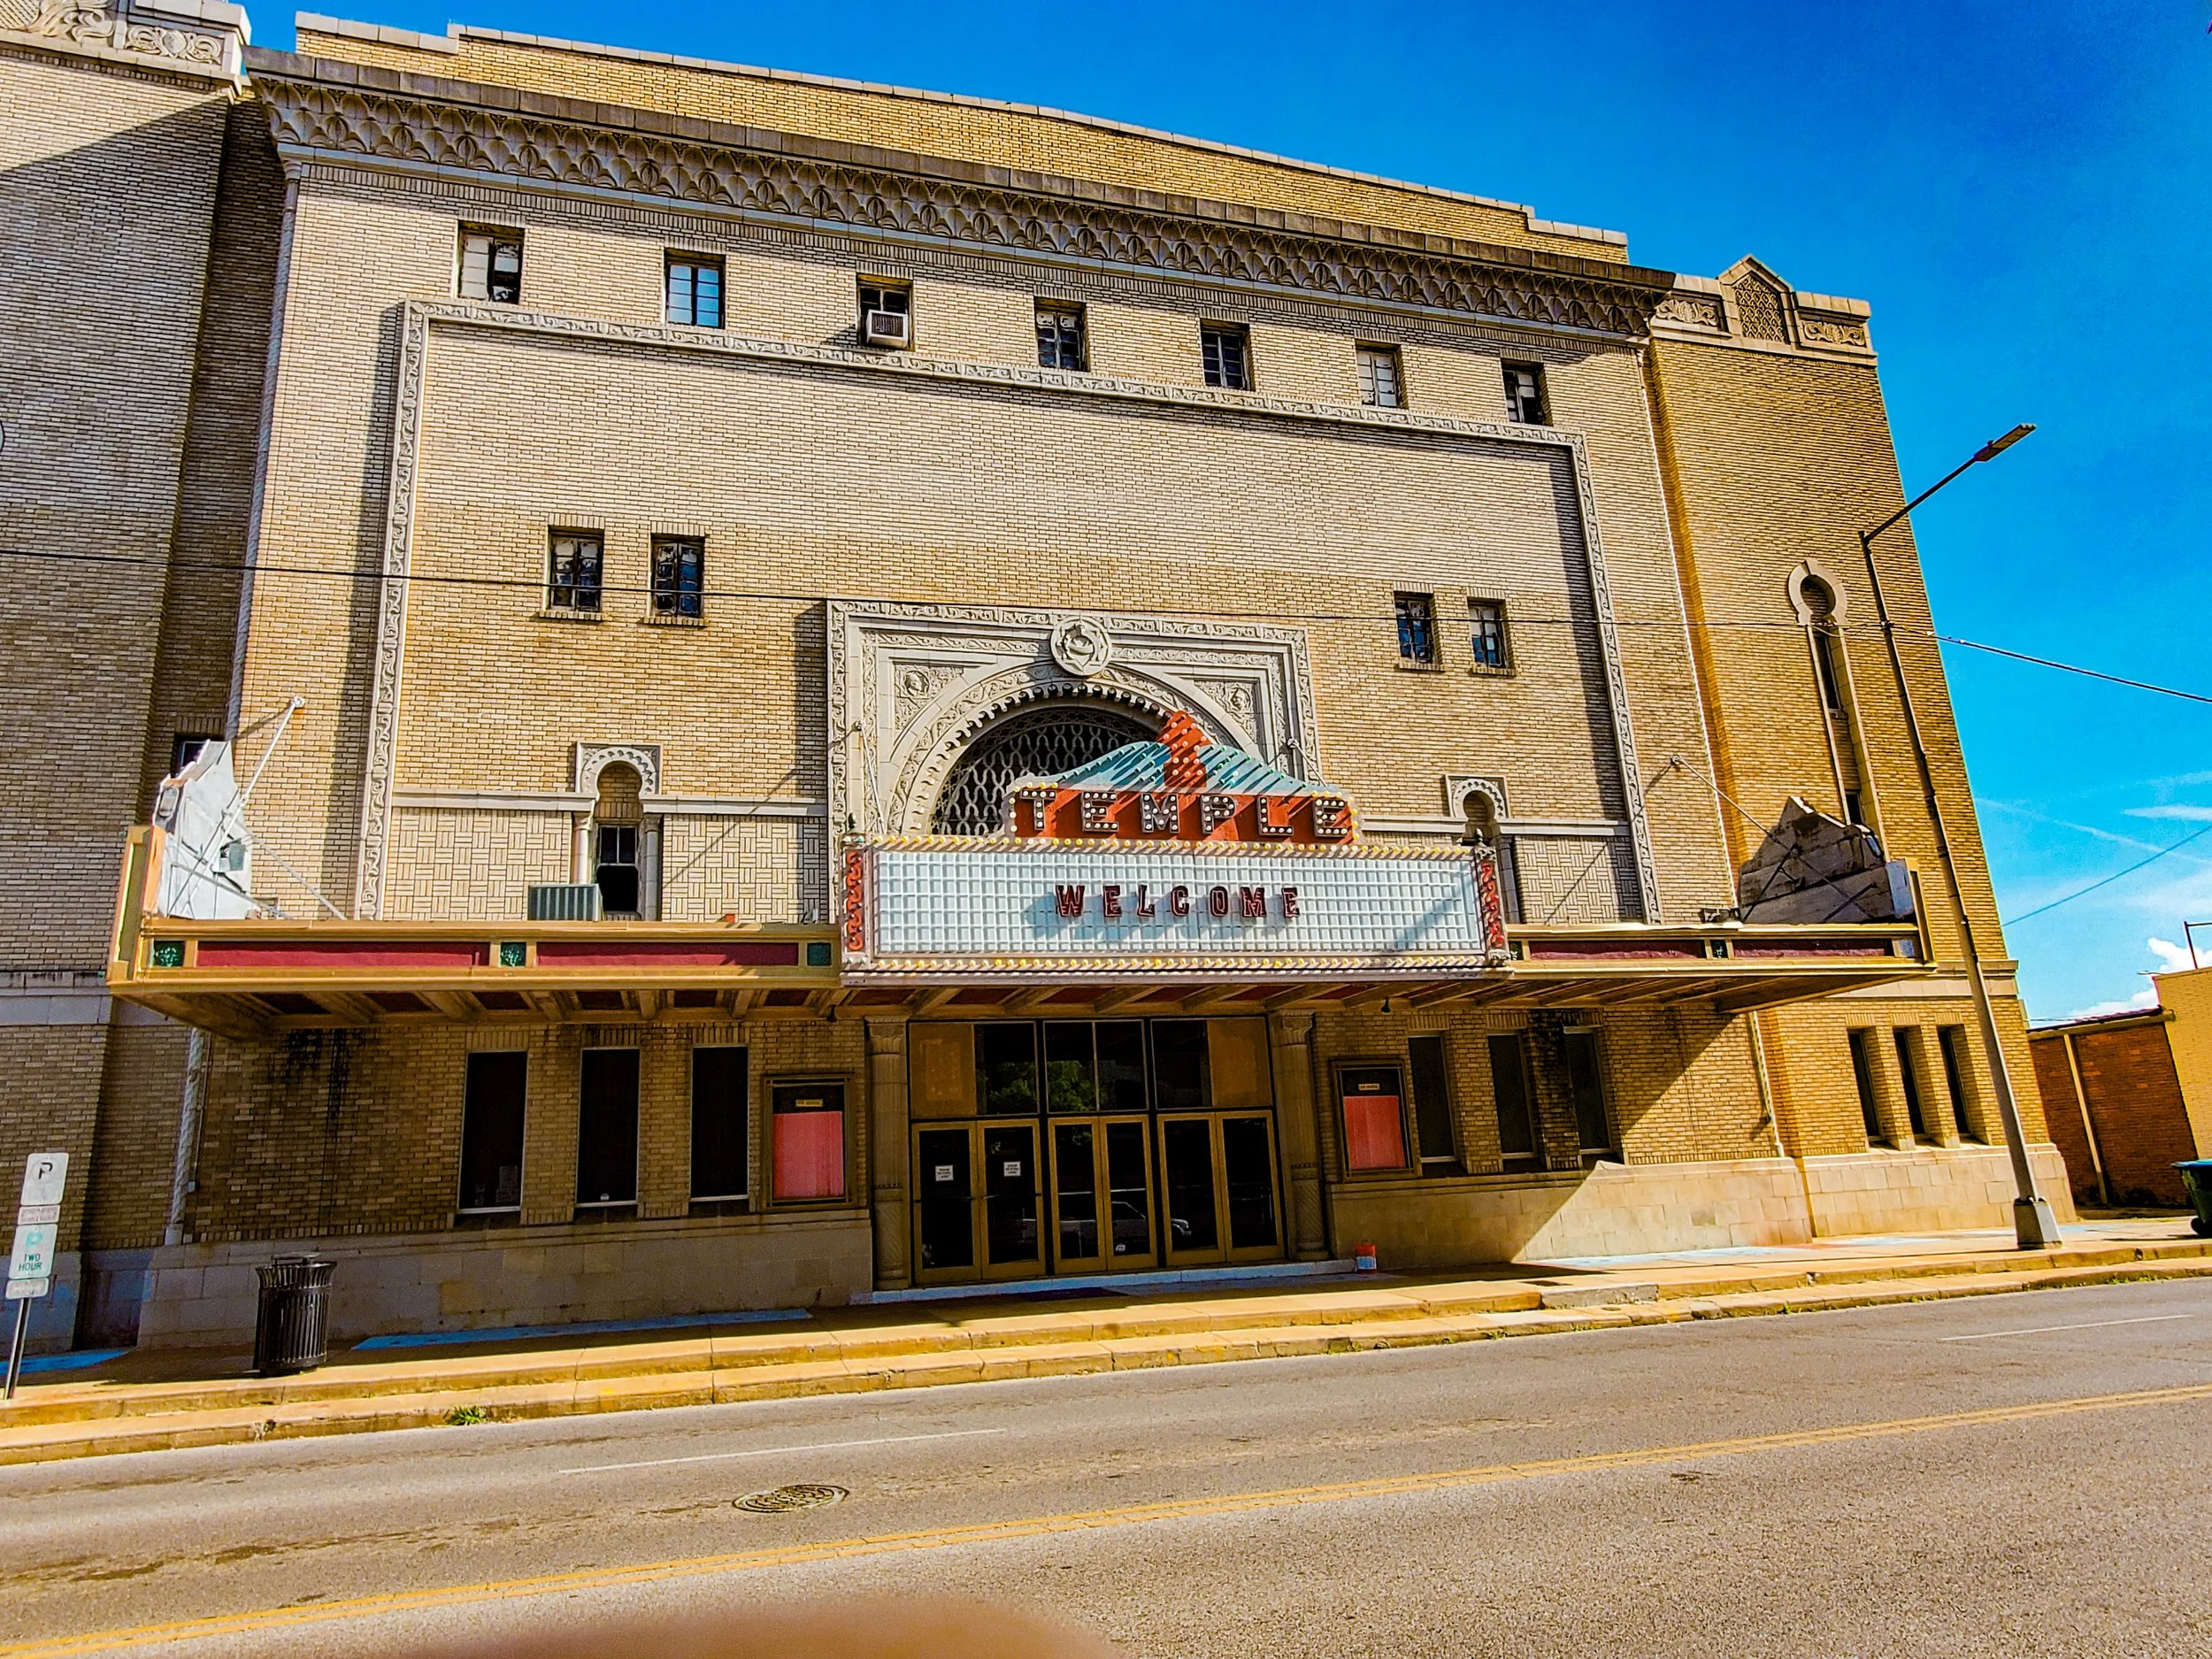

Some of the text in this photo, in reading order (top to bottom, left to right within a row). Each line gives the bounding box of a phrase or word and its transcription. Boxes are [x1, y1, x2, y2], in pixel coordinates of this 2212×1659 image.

[1020, 788, 1349, 837] TEMPLE
[1056, 885, 1301, 919] WELCOME
[38, 1162, 53, 1180] P
[25, 1232, 43, 1251] P
[19, 1262, 42, 1271] HOUR
[24, 1253, 41, 1262] TWO
